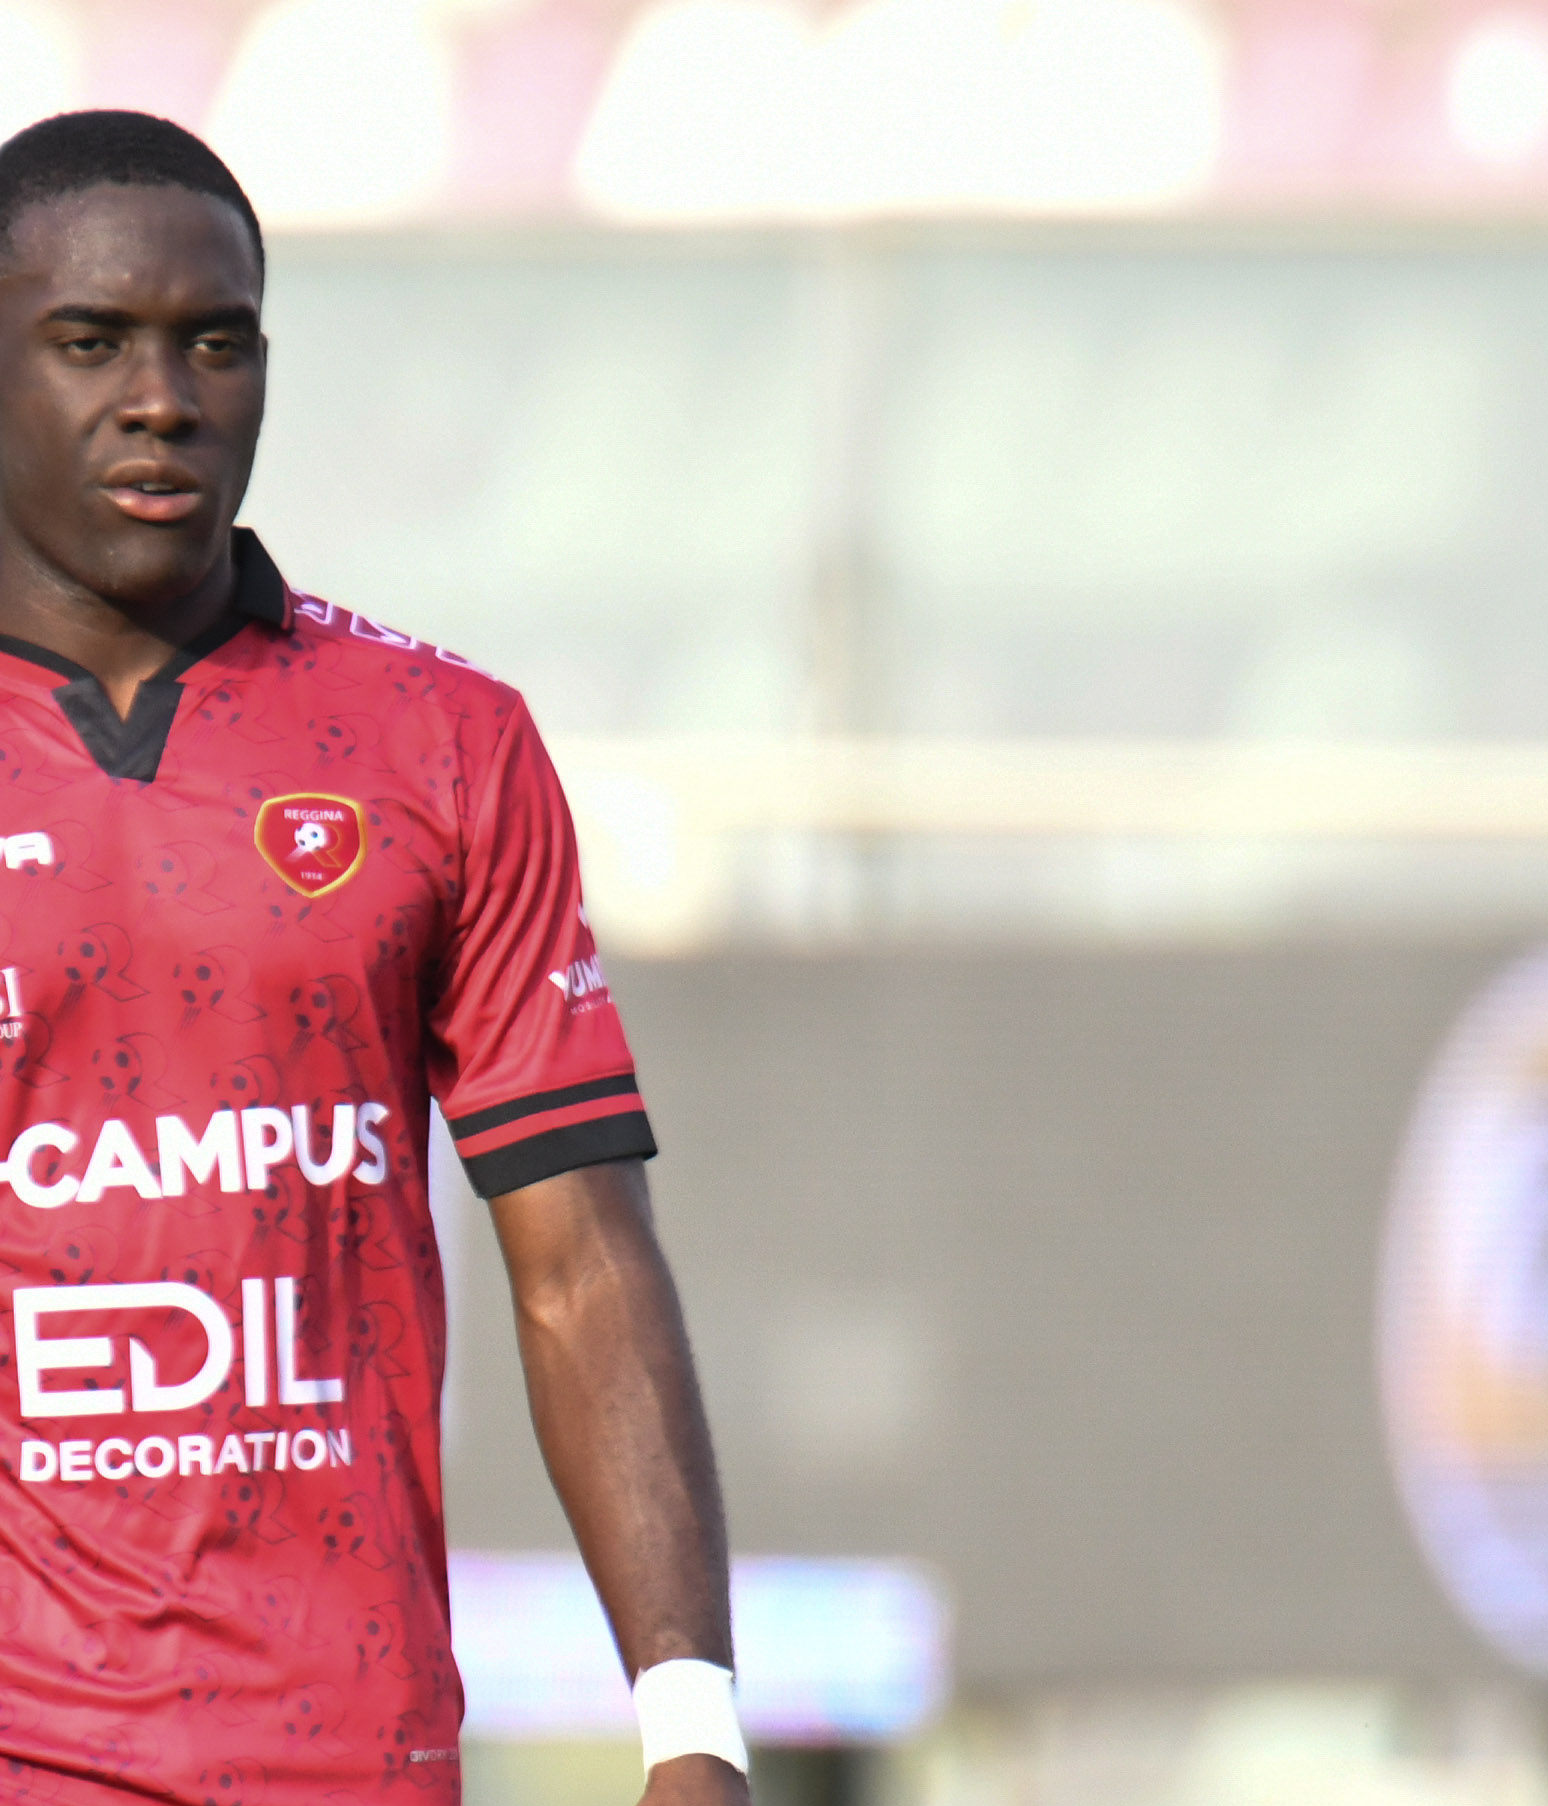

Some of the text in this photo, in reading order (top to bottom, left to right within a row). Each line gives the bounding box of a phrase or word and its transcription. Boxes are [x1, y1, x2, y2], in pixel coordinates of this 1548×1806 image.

[284, 808, 344, 821] REGGINA
[13, 1276, 343, 1417] EDIL
[19, 1428, 352, 1482] DECORATION
